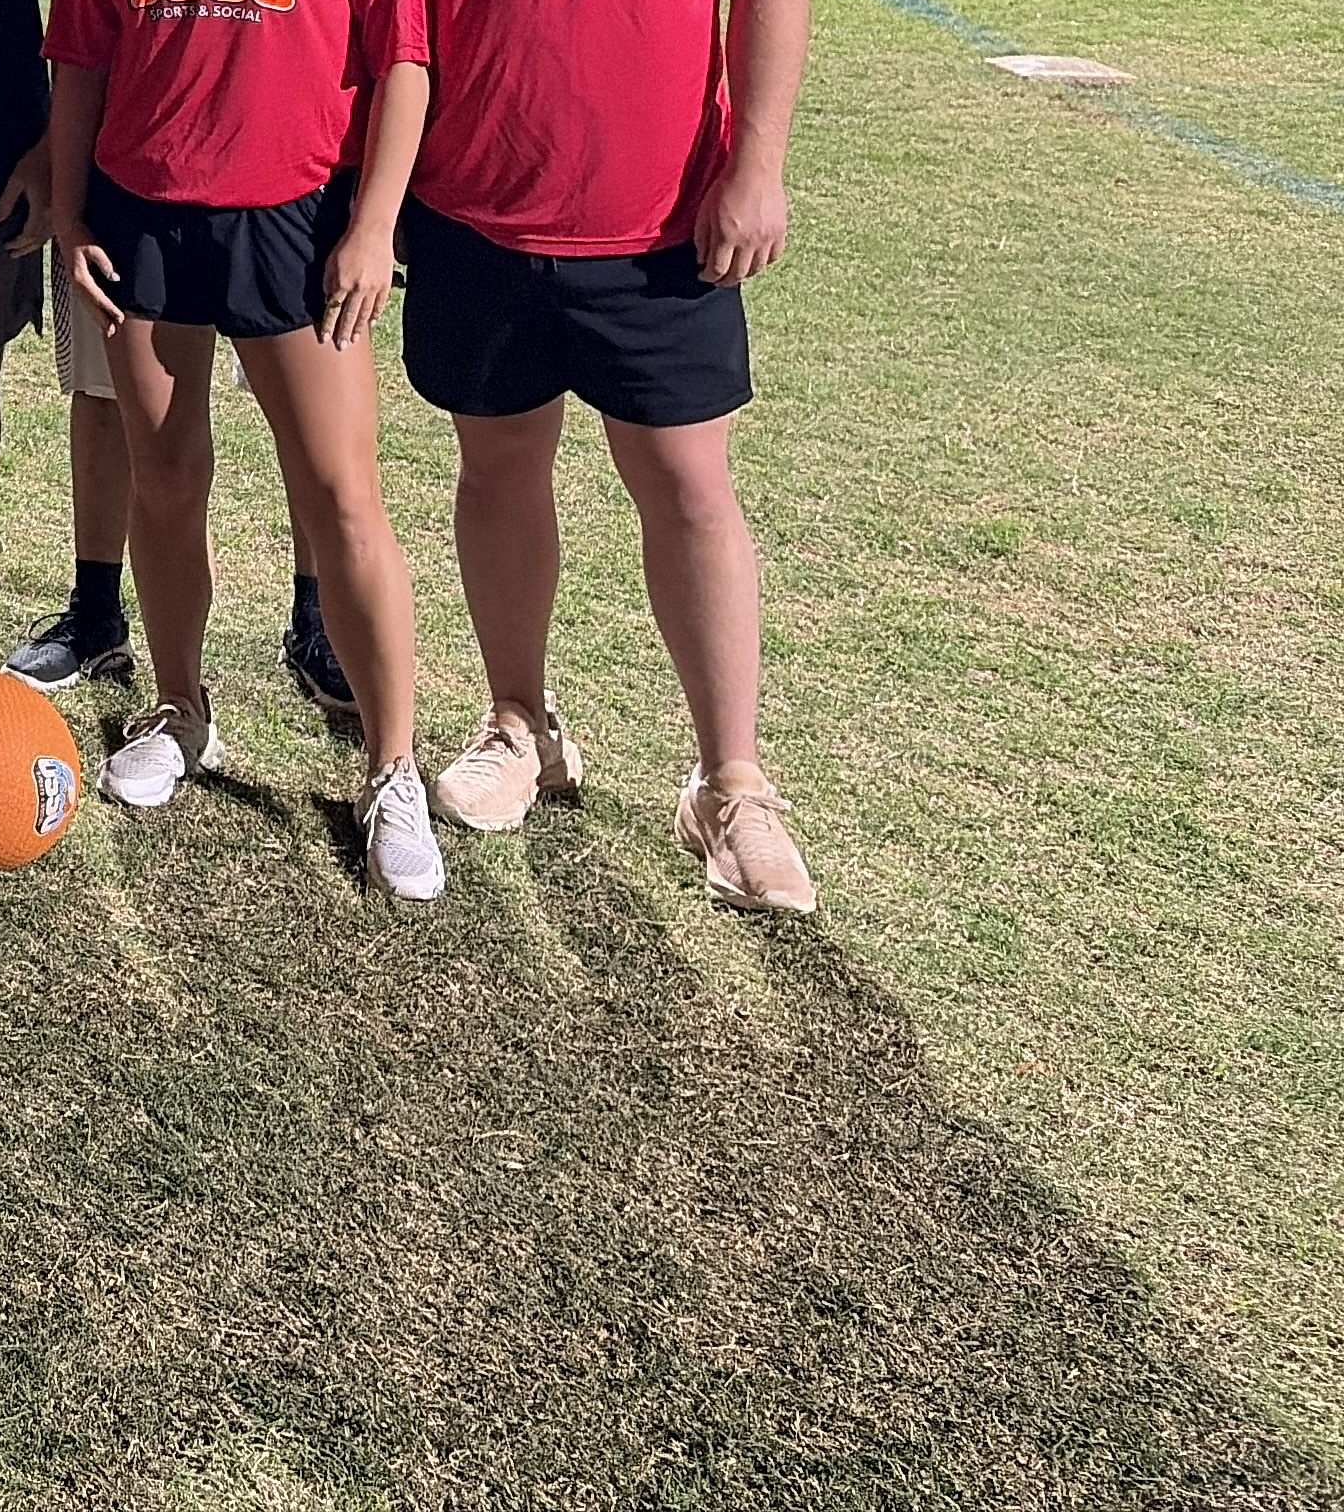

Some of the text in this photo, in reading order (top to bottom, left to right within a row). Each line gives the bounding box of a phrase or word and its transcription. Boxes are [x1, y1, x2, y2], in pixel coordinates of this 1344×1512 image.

[149, 5, 262, 23] SPORTS & SOCIAL
